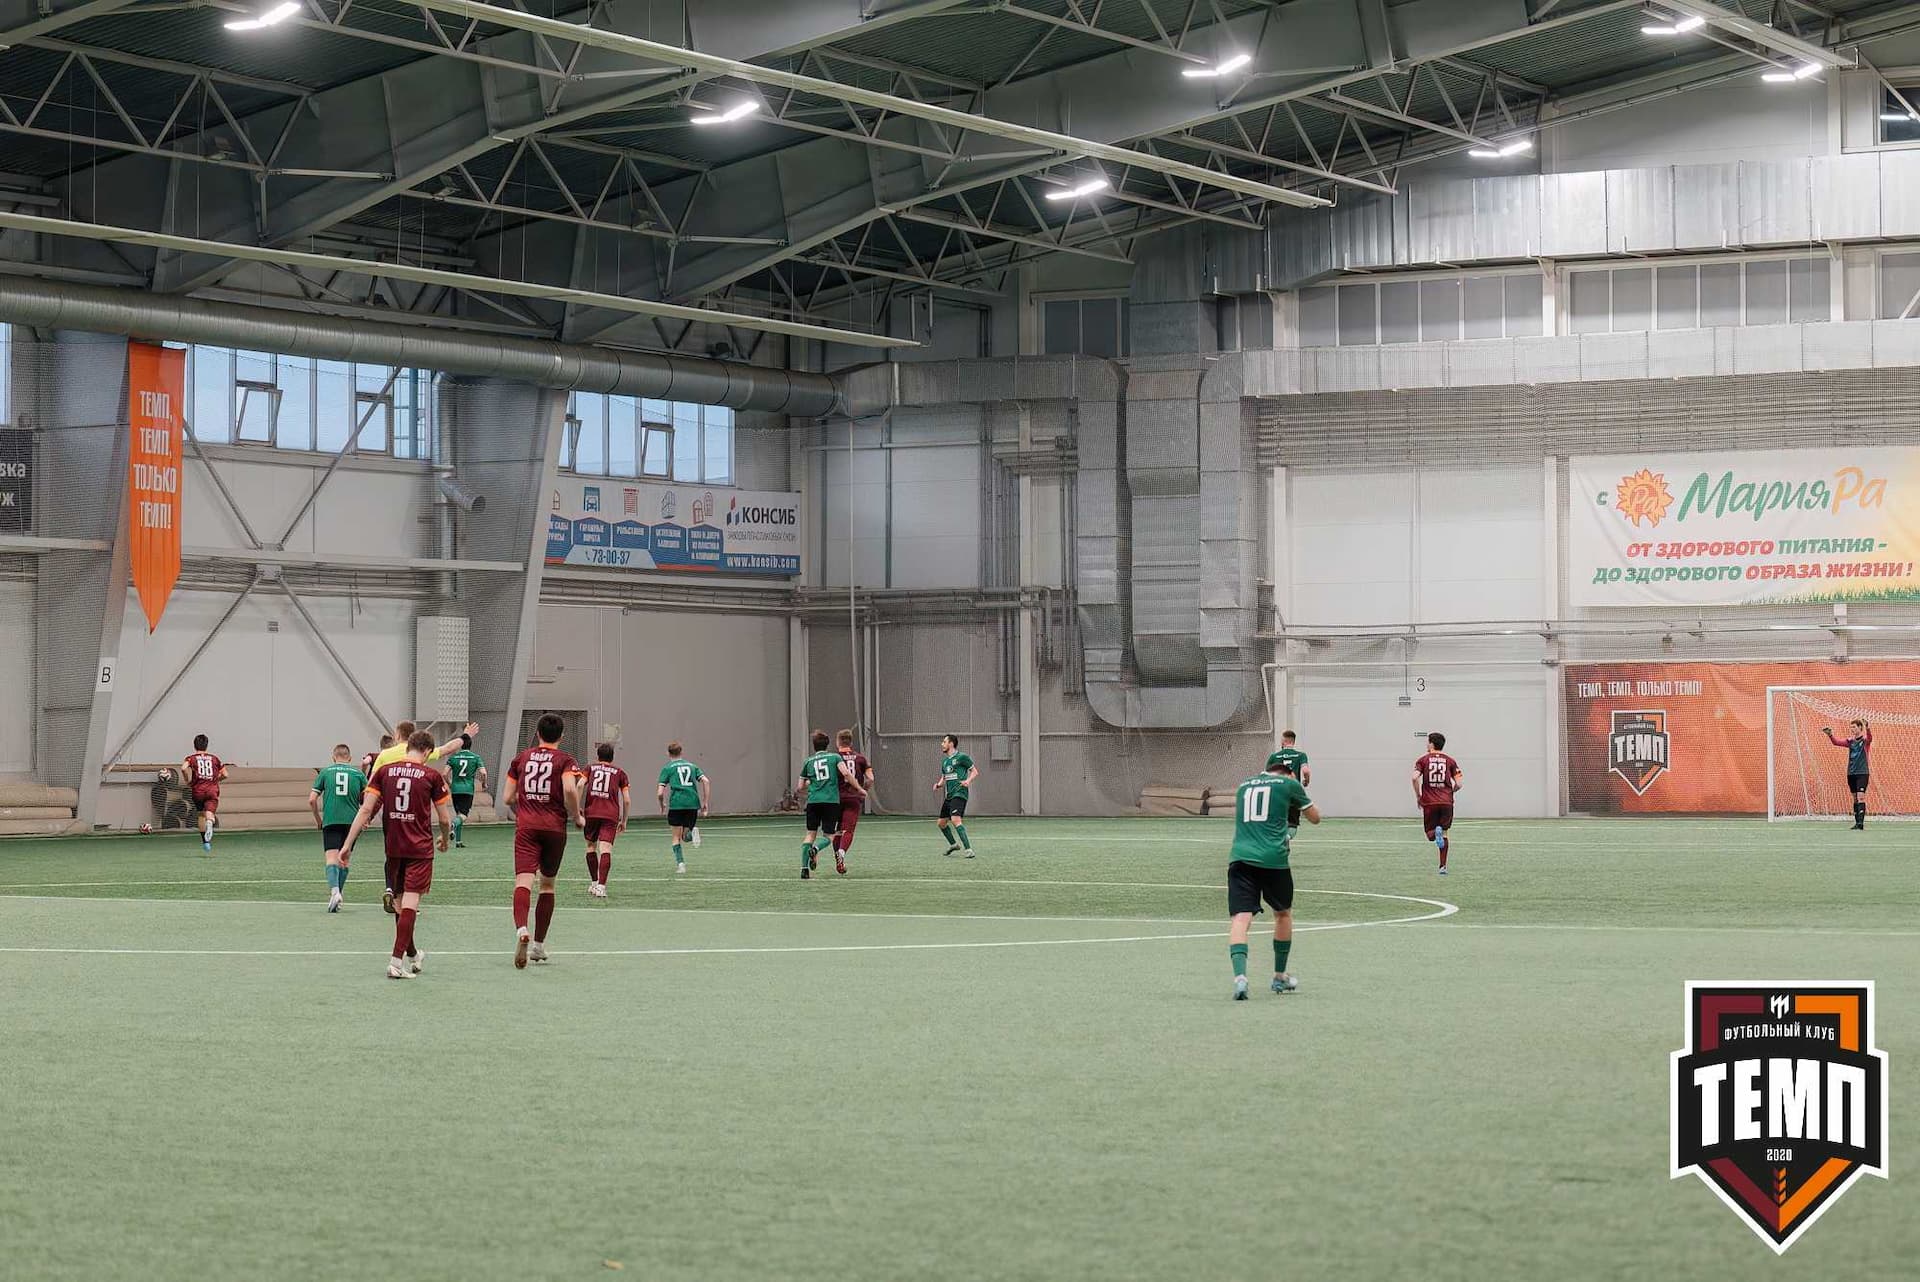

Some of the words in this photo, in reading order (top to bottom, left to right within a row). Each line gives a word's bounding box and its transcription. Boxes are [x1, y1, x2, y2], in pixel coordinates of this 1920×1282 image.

[140, 391, 173, 422] ТЕМП,
[133, 463, 177, 494] ТОЛЬКО
[140, 501, 172, 530] ТЕМП!
[742, 507, 796, 525] КОНСИБ
[592, 549, 631, 565] 73-00-37
[1626, 543, 1653, 558] ОТ
[1655, 541, 1774, 559] ЗДОРОВОГО
[1778, 538, 1875, 555] ПИТАНИЯ
[726, 555, 797, 569] www.konsib.com
[1592, 568, 1622, 584] ДО
[1624, 566, 1742, 584] ЗДОРОВОГО
[1745, 564, 1822, 580] ОБРАЗА
[1416, 677, 1426, 693] 3
[1578, 682, 1605, 698] ТЕМП,
[1636, 681, 1672, 696] ТОЛЬКО
[1674, 681, 1703, 696] ТЕМП!
[1614, 734, 1664, 763] ТЕМП
[198, 759, 213, 776] 88
[459, 759, 468, 777] 2
[524, 761, 553, 793] 22
[677, 765, 693, 786] 12
[813, 758, 830, 781] 15
[1428, 762, 1447, 782] 23
[335, 772, 349, 796] 9
[592, 770, 611, 792] 21
[395, 777, 412, 812] 3
[1243, 786, 1271, 822] 10
